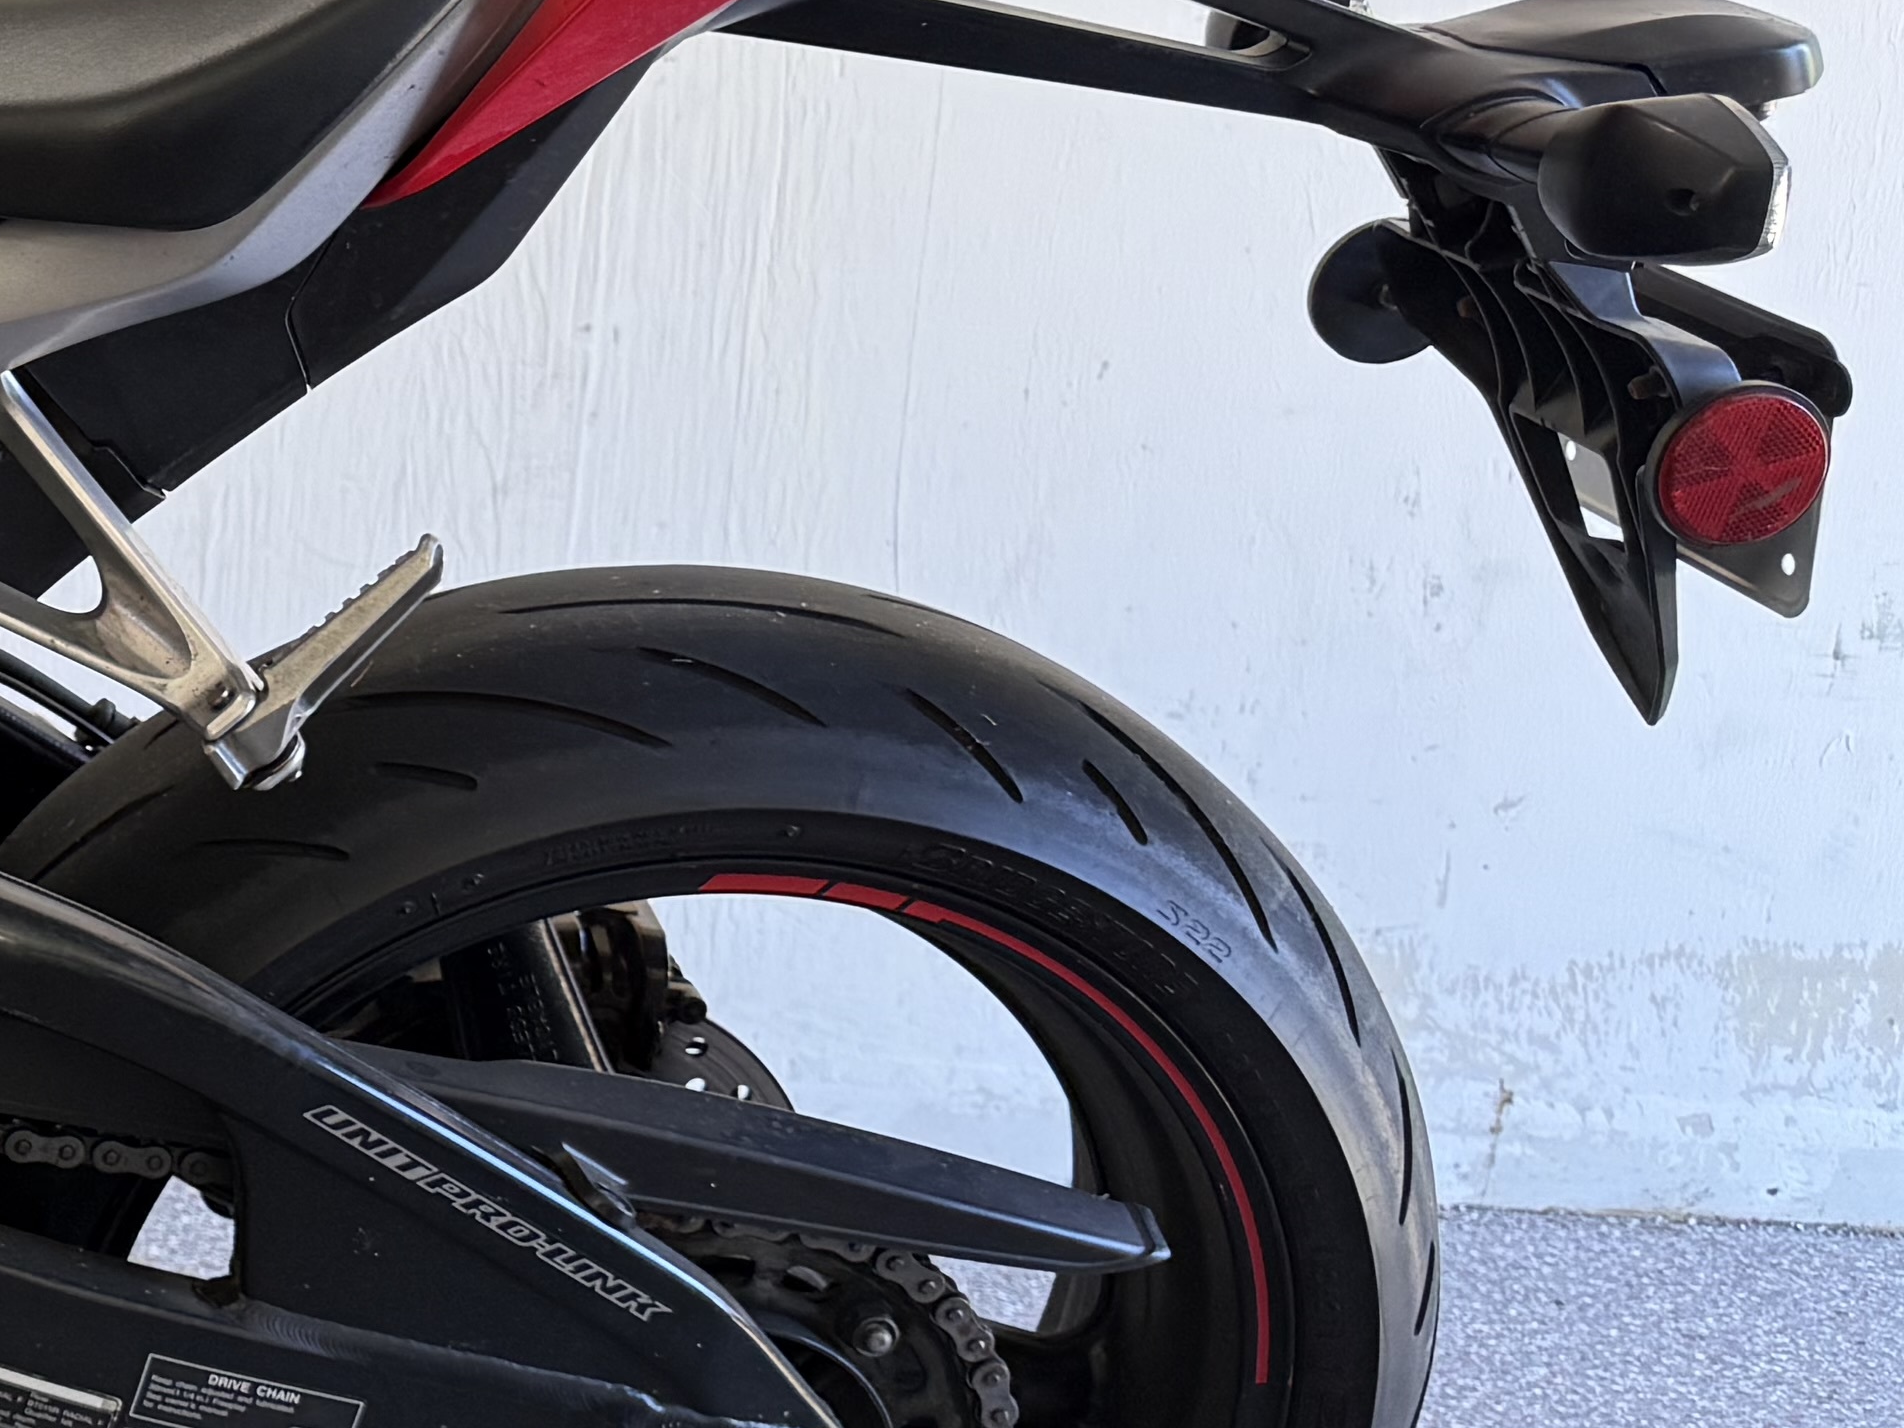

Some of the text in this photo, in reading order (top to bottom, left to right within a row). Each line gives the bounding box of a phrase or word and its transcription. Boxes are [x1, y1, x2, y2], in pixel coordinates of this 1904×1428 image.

[304, 1105, 673, 1321] UNIT PRO-LINK
[208, 1374, 251, 1394] DRIVE
[256, 1384, 300, 1404] CHAIN
